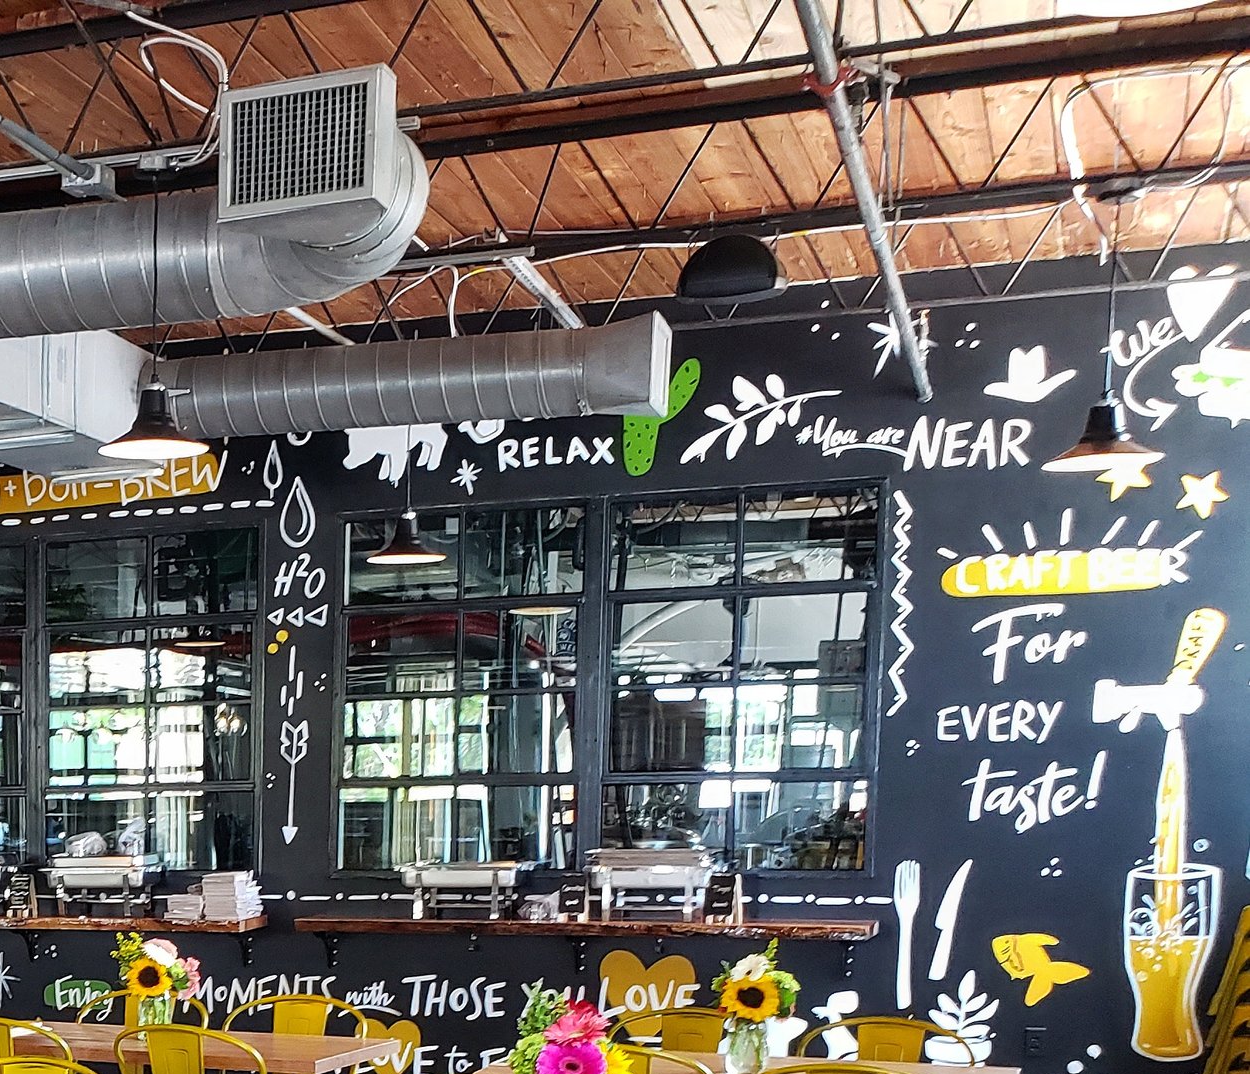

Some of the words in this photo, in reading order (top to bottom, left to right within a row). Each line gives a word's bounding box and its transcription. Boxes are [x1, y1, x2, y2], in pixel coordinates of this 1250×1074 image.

[497, 435, 616, 472] RELAX
[902, 415, 1032, 472] NEAR
[955, 550, 1082, 593] CRAFT
[1087, 548, 1189, 588] BEER
[971, 603, 1088, 684] For
[936, 700, 1065, 744] EVERY
[961, 750, 1107, 834] taste!
[54, 975, 114, 1021] Enjoy
[342, 980, 398, 1010] with
[401, 973, 508, 1021] THOSE
[598, 976, 701, 1019] LOVE
